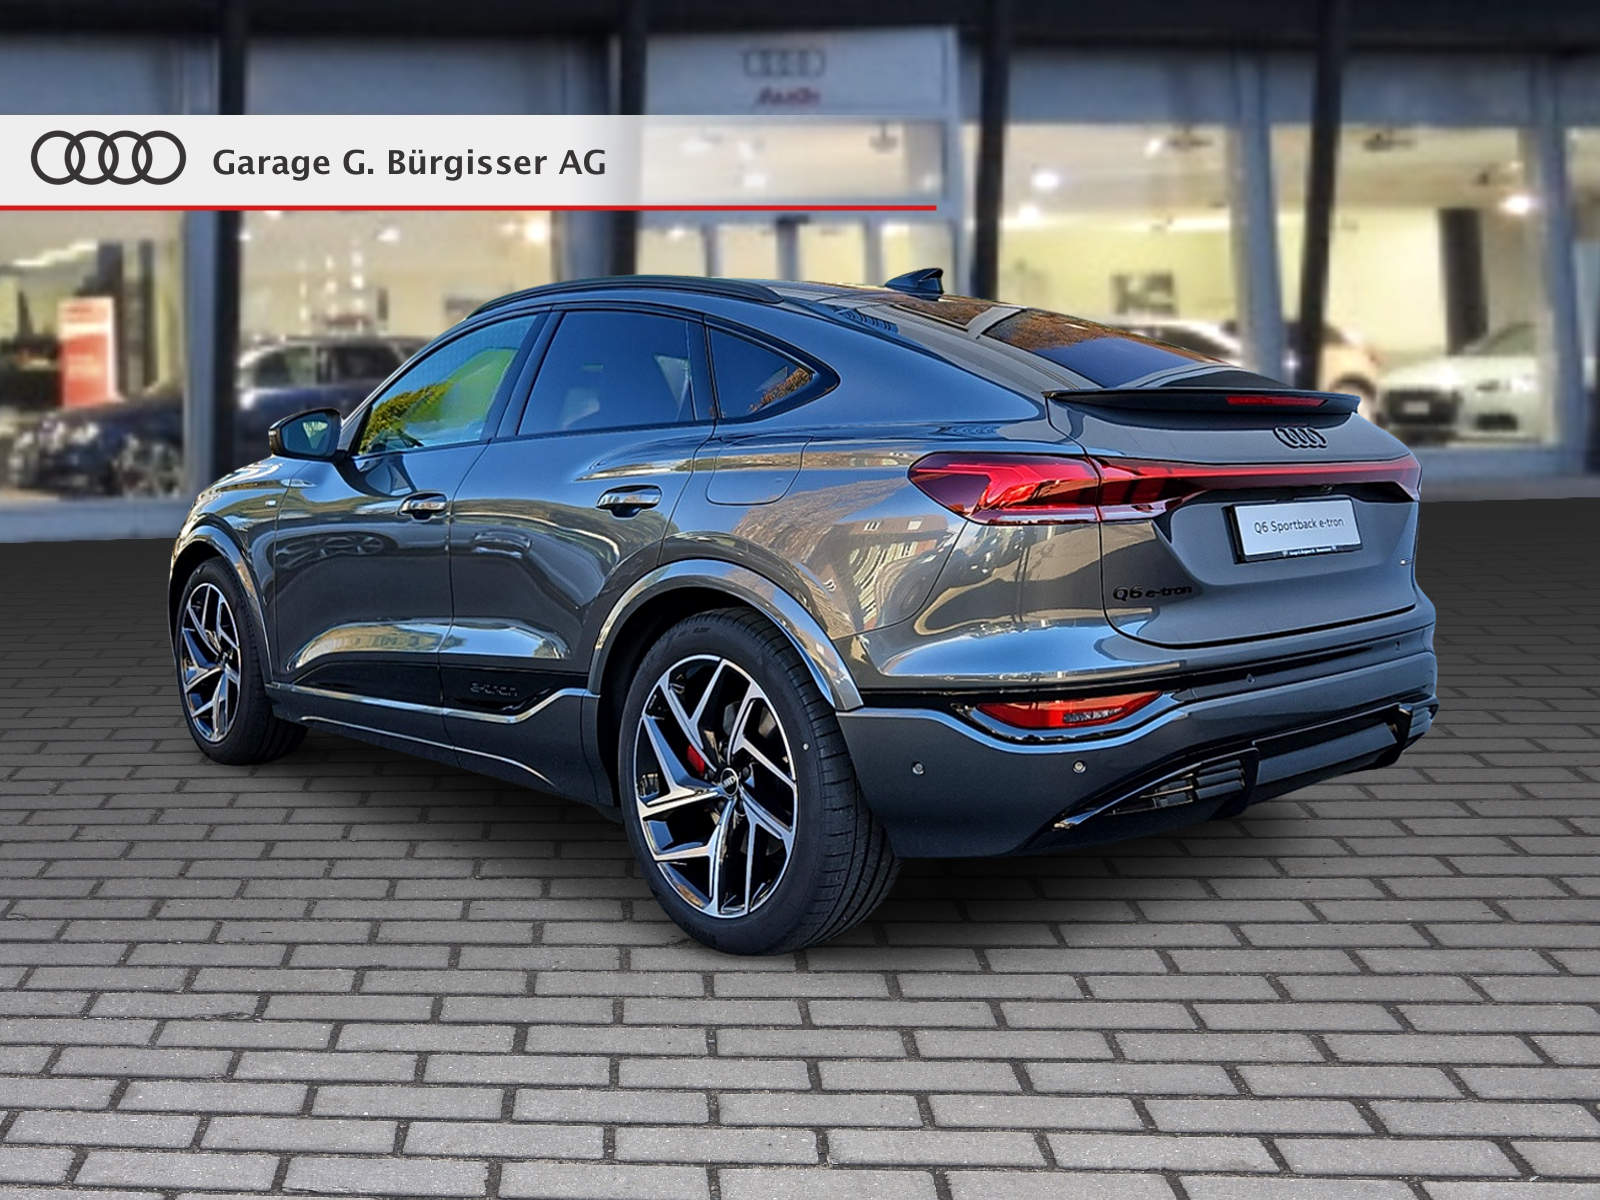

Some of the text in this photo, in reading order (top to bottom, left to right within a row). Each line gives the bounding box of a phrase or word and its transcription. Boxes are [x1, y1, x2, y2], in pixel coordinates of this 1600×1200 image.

[1254, 516, 1345, 535] Q6 Sportback e-tron
[1112, 585, 1194, 602] Q6 e-tron
